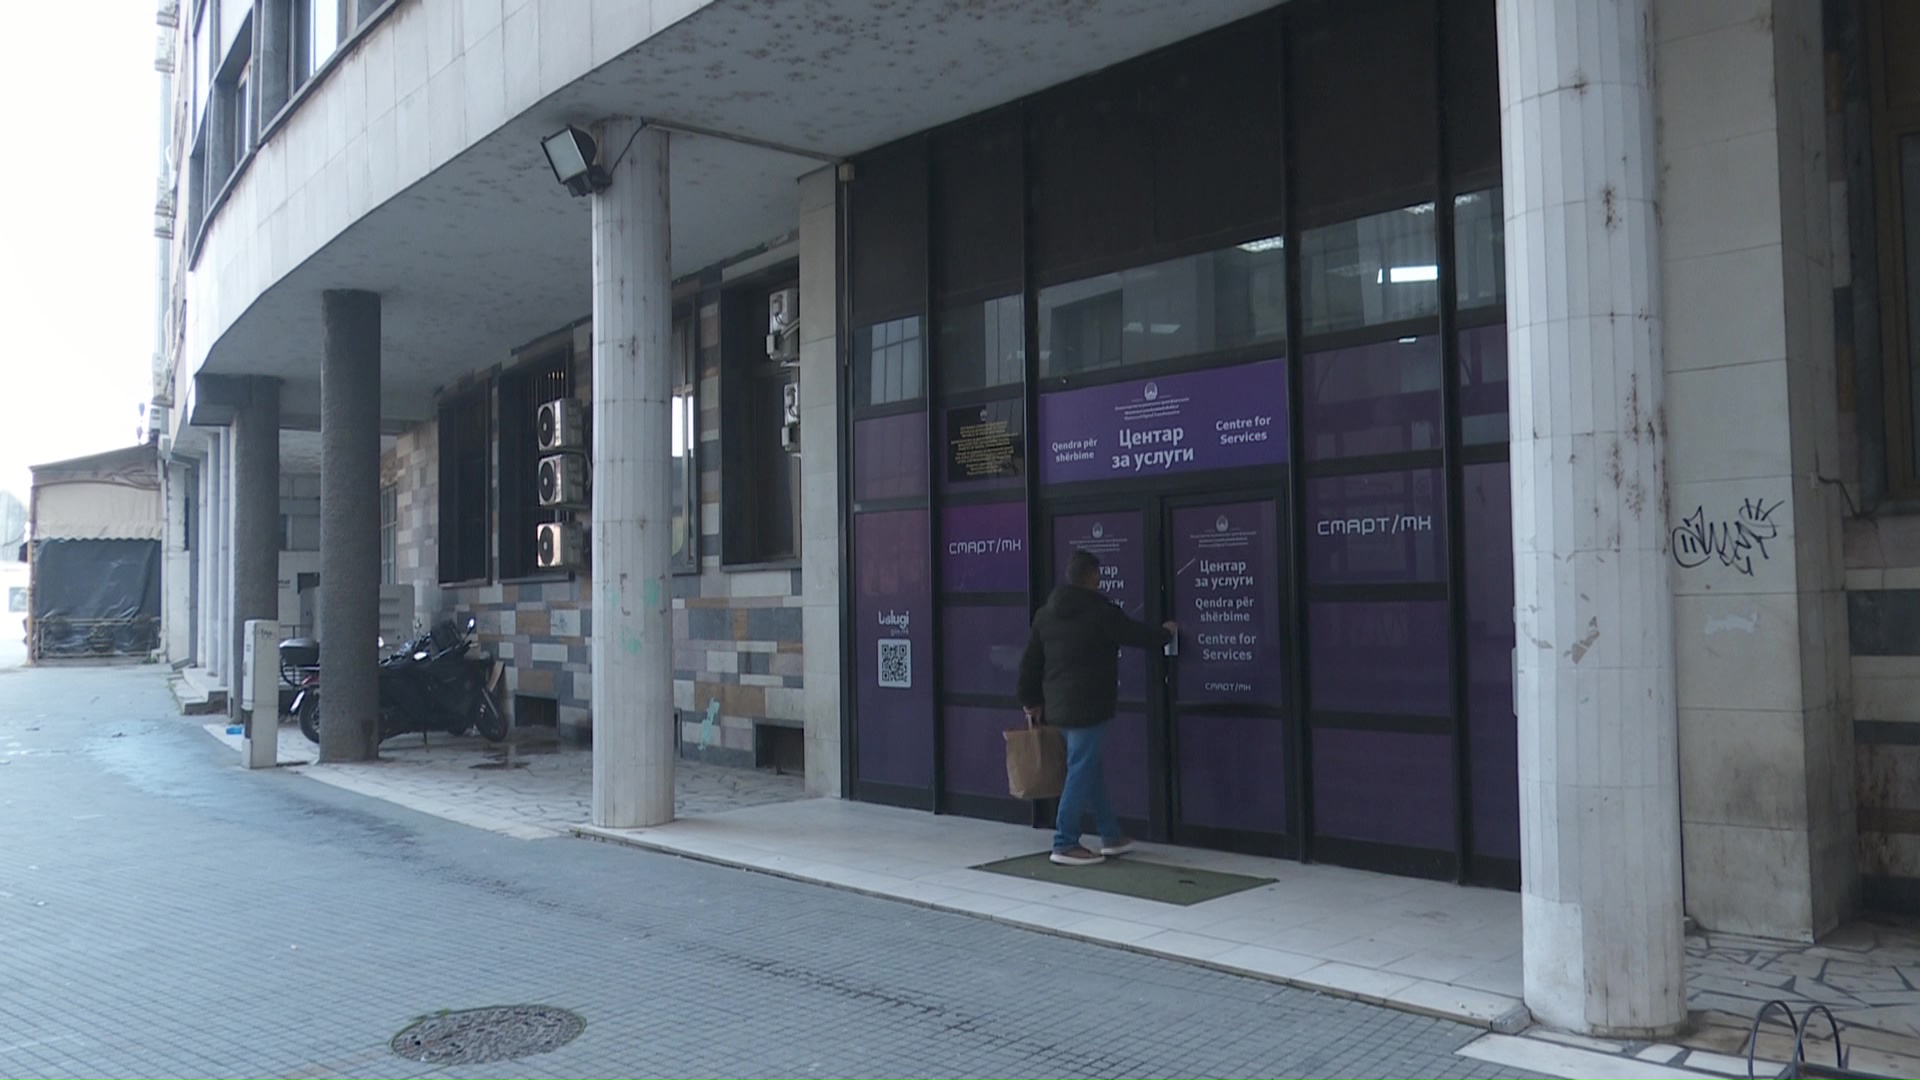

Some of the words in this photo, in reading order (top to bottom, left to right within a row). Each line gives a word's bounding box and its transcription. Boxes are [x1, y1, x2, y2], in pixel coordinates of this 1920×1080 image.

[1215, 418, 1253, 431] Centre
[1254, 415, 1271, 427] for
[1119, 427, 1184, 449] Центар
[1220, 430, 1267, 445] Services
[1052, 440, 1082, 452] Qendra
[1083, 438, 1097, 451] për
[1055, 450, 1094, 463] shërbime
[1111, 453, 1130, 469] за
[1134, 447, 1194, 472] услуги
[1099, 565, 1118, 578] тар
[1200, 559, 1246, 574] Центар
[1098, 578, 1124, 592] луги
[1194, 577, 1208, 588] за
[1211, 575, 1254, 591] услуги
[1195, 598, 1233, 611] Qendra
[1236, 597, 1254, 611] për
[1200, 611, 1250, 622] shërbime
[1198, 632, 1236, 645] Centre
[1239, 632, 1256, 645] for
[1202, 648, 1252, 661] Services
